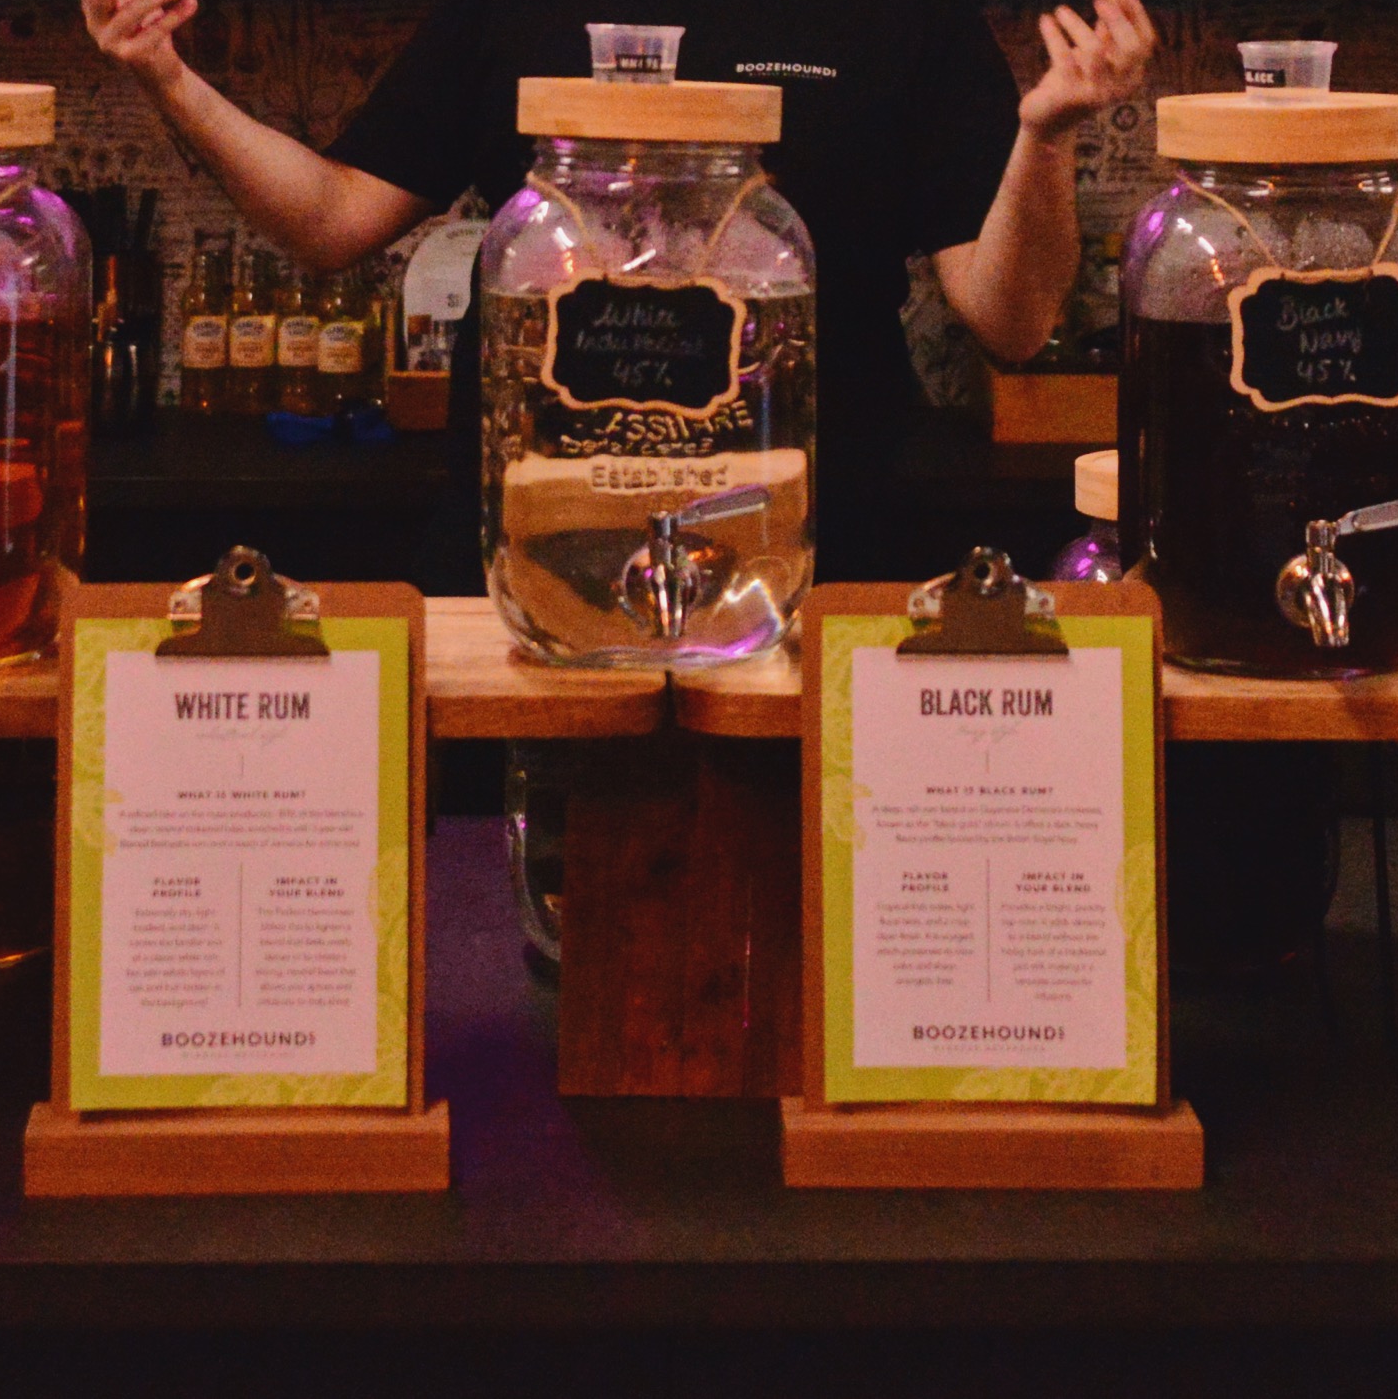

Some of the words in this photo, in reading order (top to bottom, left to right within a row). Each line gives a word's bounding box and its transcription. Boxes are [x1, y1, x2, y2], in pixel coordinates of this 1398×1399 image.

[1275, 296, 1350, 332] Black
[174, 691, 250, 720] WHITE
[258, 691, 311, 720] RUM
[920, 688, 994, 717] BLACK
[1002, 688, 1053, 716] RUM
